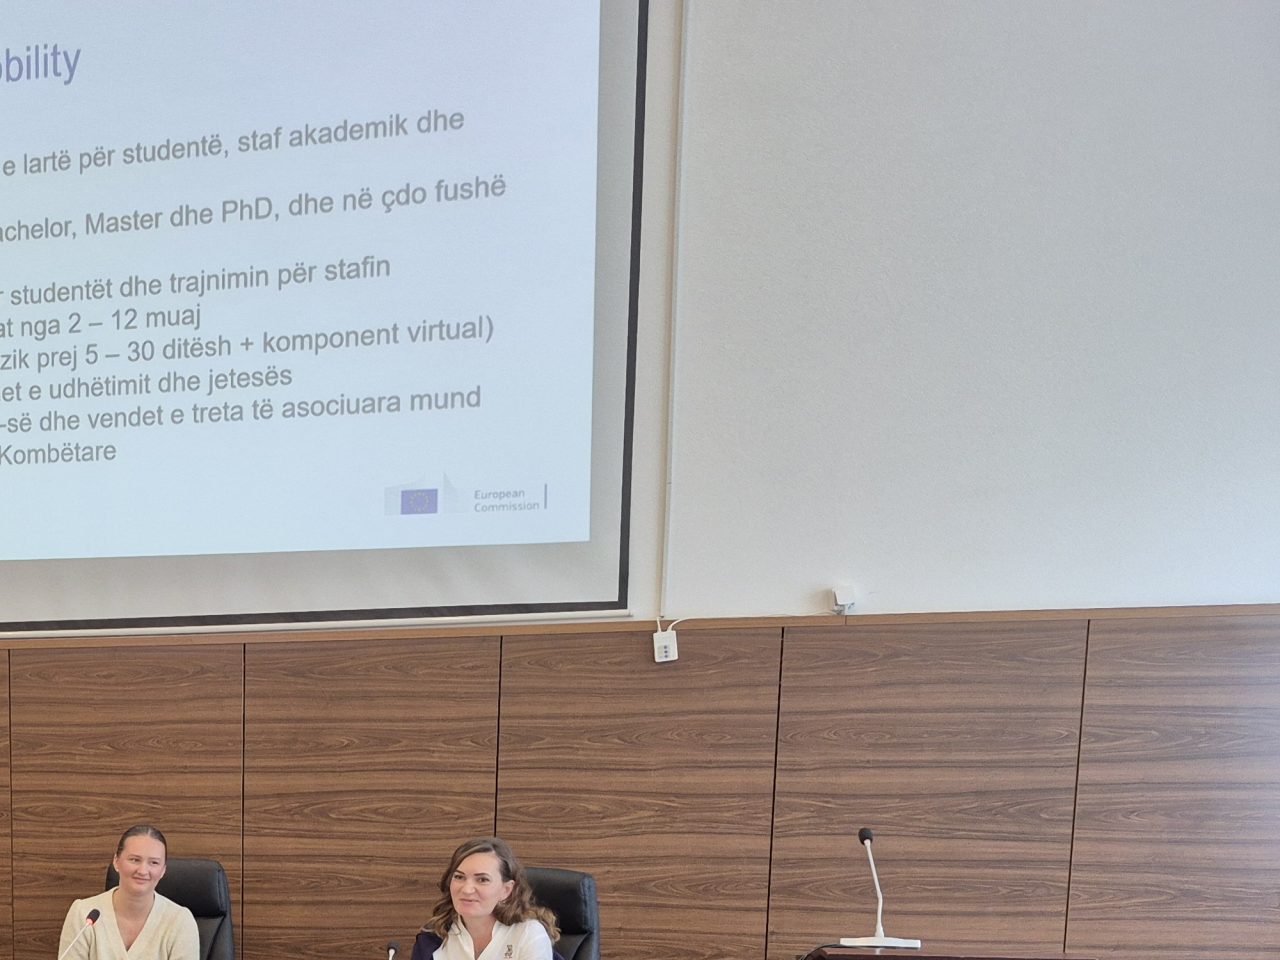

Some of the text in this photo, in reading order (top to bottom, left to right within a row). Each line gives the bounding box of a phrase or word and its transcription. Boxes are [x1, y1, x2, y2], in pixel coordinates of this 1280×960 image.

[2, 159, 16, 177] e
[23, 149, 72, 175] lartë
[79, 145, 117, 176] për
[122, 133, 229, 165] studentë,
[237, 125, 284, 153] staf
[288, 112, 409, 148] akademik
[416, 108, 465, 134] dhe
[85, 209, 164, 236] Master
[169, 203, 214, 228] dhe
[221, 196, 280, 224] PhD,
[288, 192, 335, 217] dhe
[342, 186, 374, 212] në
[381, 182, 428, 214] çdo
[434, 173, 507, 203] fushë
[10, 277, 114, 306] studentët
[119, 274, 163, 298] dhe
[168, 264, 269, 298] trajnimin
[277, 261, 318, 292] për
[324, 254, 391, 282] stafin
[20, 318, 61, 342] nga
[67, 311, 83, 335] 2
[111, 307, 138, 331] 12
[145, 302, 201, 332] muaj
[37, 344, 78, 374] prej
[84, 342, 99, 366] 5
[127, 339, 155, 363] 30
[161, 334, 232, 361] ditësh
[239, 336, 255, 352] +
[262, 322, 400, 357] komponent
[406, 314, 495, 345] virtual)
[28, 384, 42, 401] e
[49, 372, 152, 400] udhëtimit
[157, 370, 201, 394] dhe
[208, 364, 293, 397] jetesës
[39, 409, 81, 432] dhe
[86, 404, 164, 430] vendet
[170, 408, 185, 425] e
[191, 401, 244, 424] treta
[250, 397, 274, 421] të
[281, 392, 401, 419] asociuara
[409, 384, 481, 412] mund
[473, 489, 526, 501] European
[473, 501, 540, 513] Commission
